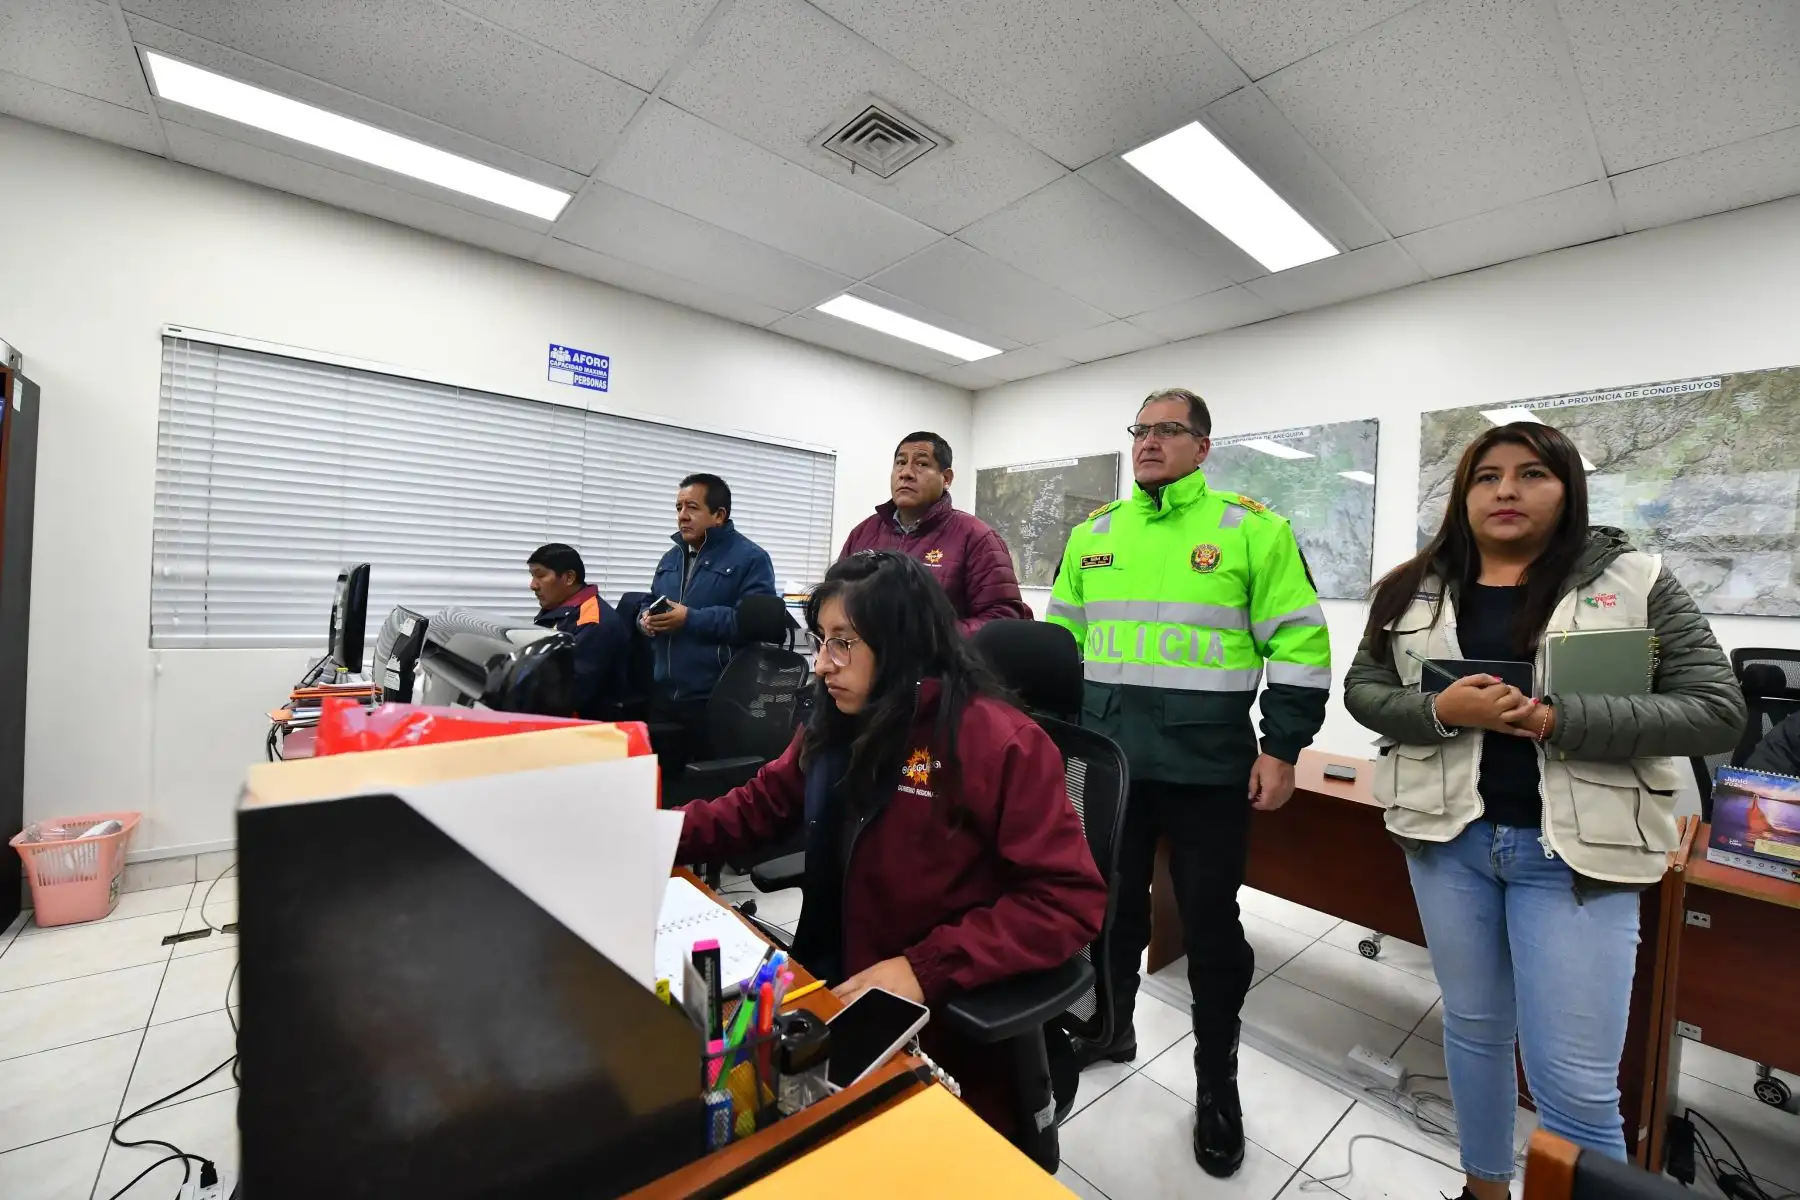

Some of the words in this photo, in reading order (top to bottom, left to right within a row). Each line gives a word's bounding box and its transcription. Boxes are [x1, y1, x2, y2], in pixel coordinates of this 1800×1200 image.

[549, 359, 583, 372] CAPACIDAD
[584, 367, 607, 377] MAXIMA
[572, 352, 608, 369] AFORO
[574, 374, 607, 390] PERSONAS
[1553, 399, 1566, 407] LA
[1567, 392, 1622, 405] PROVINCIA
[1624, 389, 1639, 398] DE
[1641, 380, 1721, 396] CONDESUYOS
[1273, 431, 1304, 440] AREQUIPA
[1087, 625, 1225, 665] OLICIA
